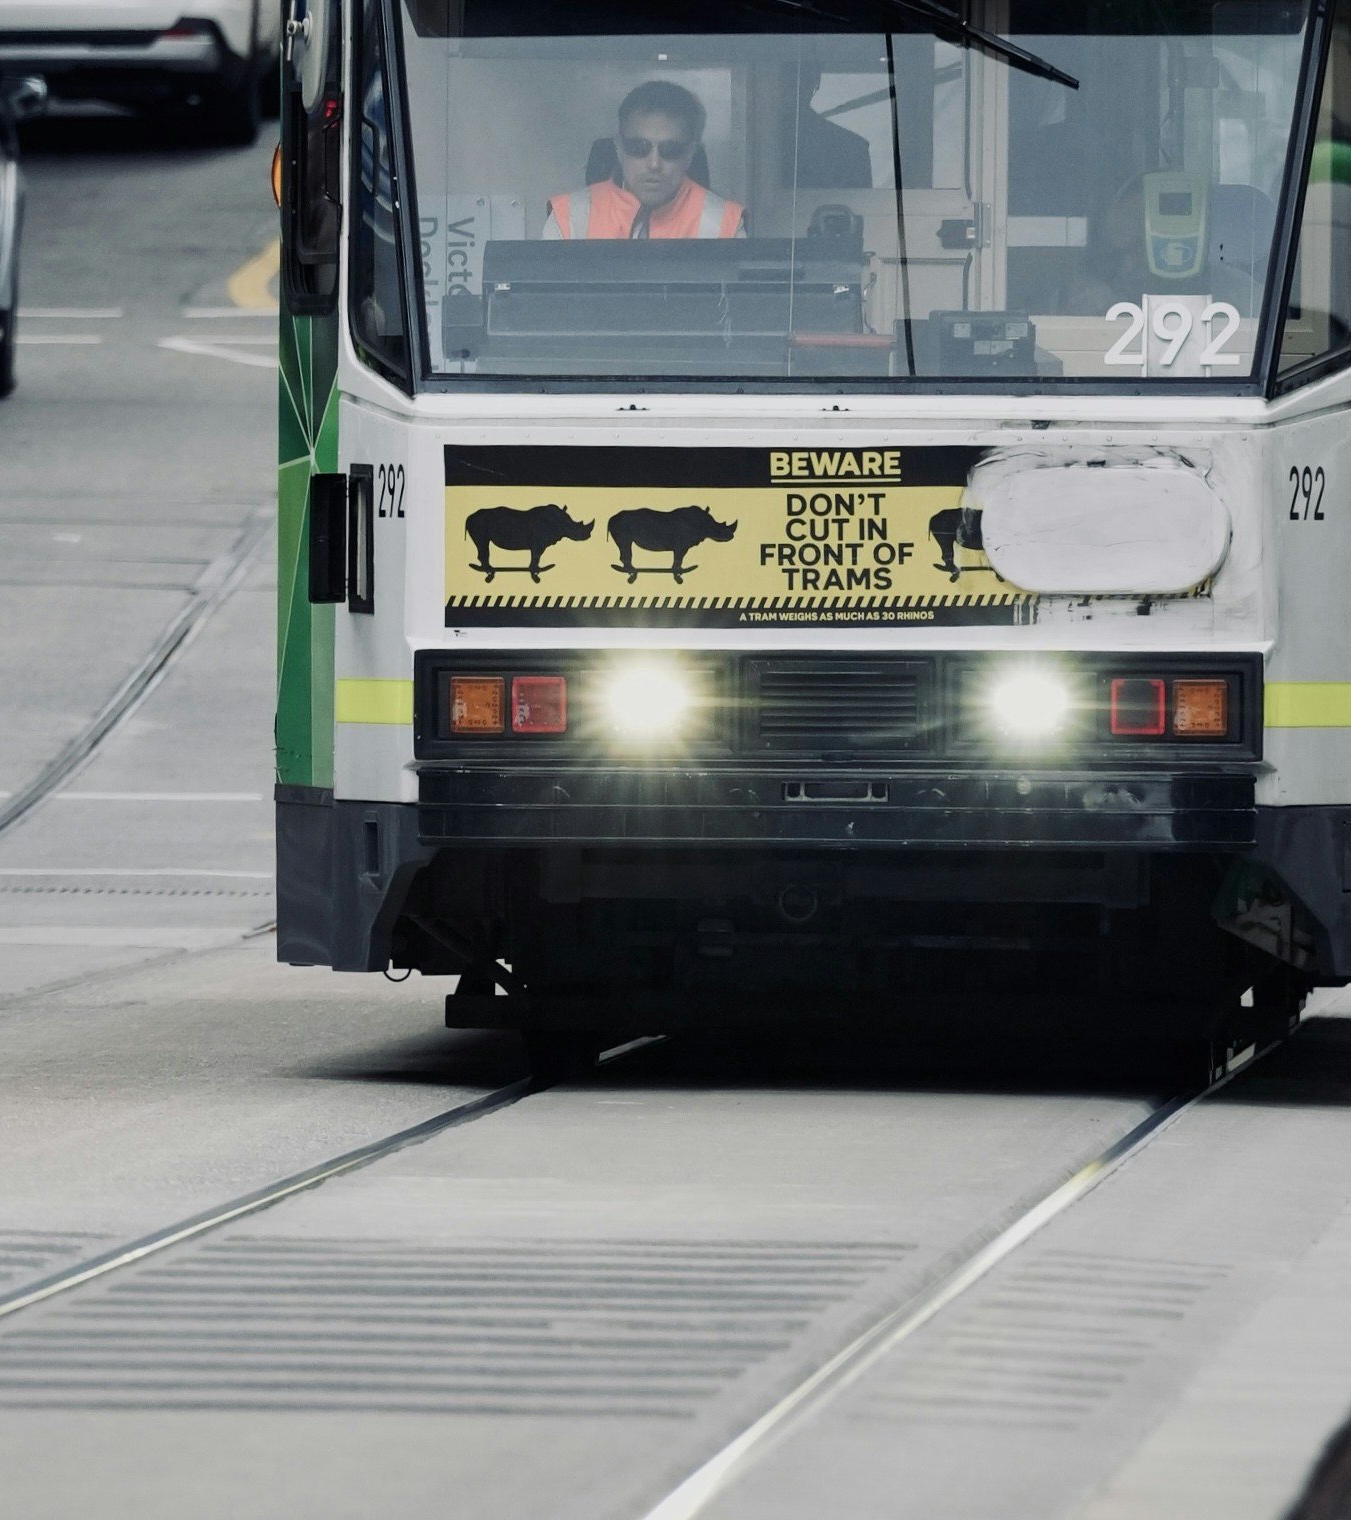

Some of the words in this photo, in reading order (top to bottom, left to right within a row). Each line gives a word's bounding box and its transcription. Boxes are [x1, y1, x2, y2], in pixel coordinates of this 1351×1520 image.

[1104, 301, 1241, 366] 292
[769, 451, 902, 477] BEWARE
[378, 463, 406, 518] 292
[1289, 465, 1325, 521] 292
[786, 493, 886, 517] DON'T
[785, 518, 850, 542] CUT
[859, 517, 888, 540] IN
[759, 543, 864, 567] FRONT
[872, 542, 915, 565] OF
[781, 567, 893, 591] TRAMS
[739, 613, 747, 622] A
[748, 613, 777, 622] TRAM
[778, 612, 818, 622] WEIGHS
[819, 612, 834, 621] AS
[835, 612, 865, 621] MUCH
[865, 612, 880, 621] AS
[881, 612, 895, 620] 30
[896, 611, 935, 620] RHINOS
